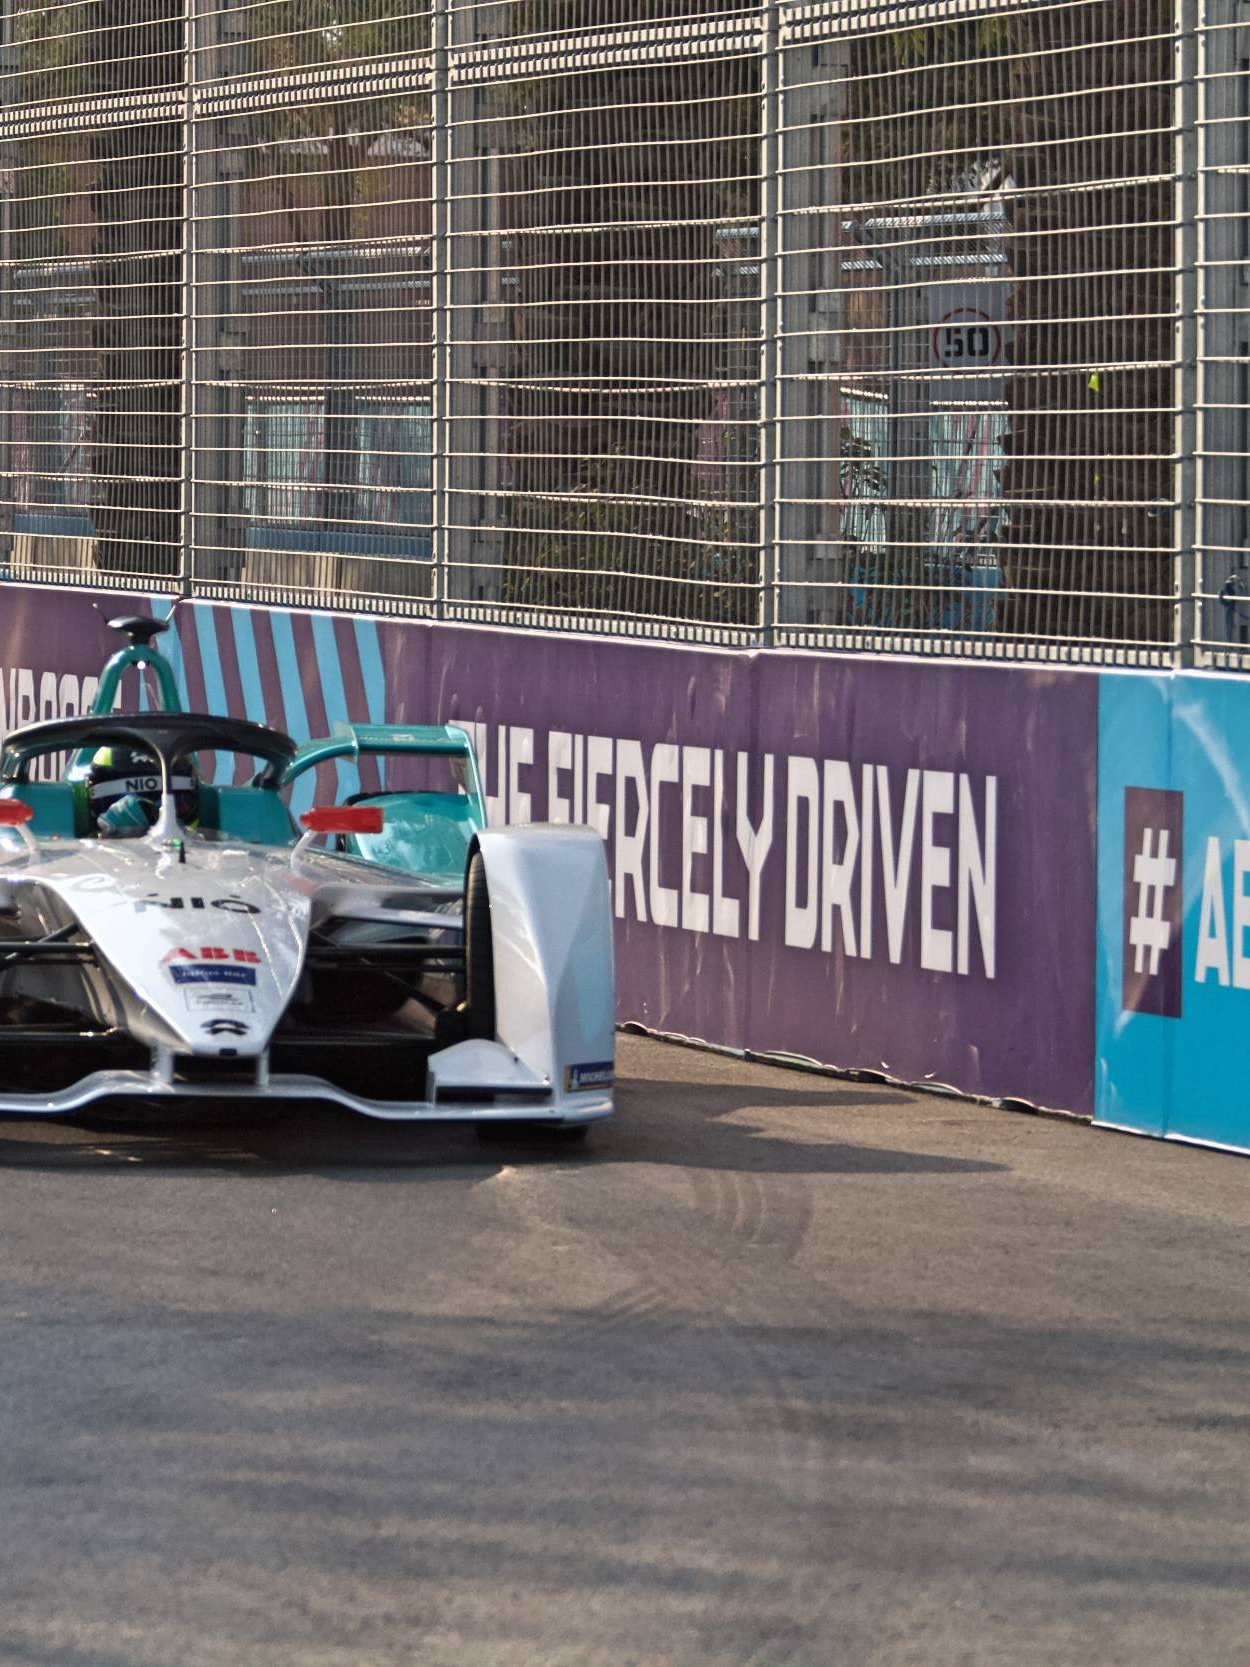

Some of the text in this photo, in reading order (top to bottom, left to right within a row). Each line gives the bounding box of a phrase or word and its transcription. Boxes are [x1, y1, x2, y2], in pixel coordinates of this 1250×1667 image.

[944, 326, 990, 357] 50
[125, 777, 158, 792] NIO
[448, 719, 534, 826] HE
[784, 755, 997, 980] DRIVEN
[160, 946, 262, 964] ABB
